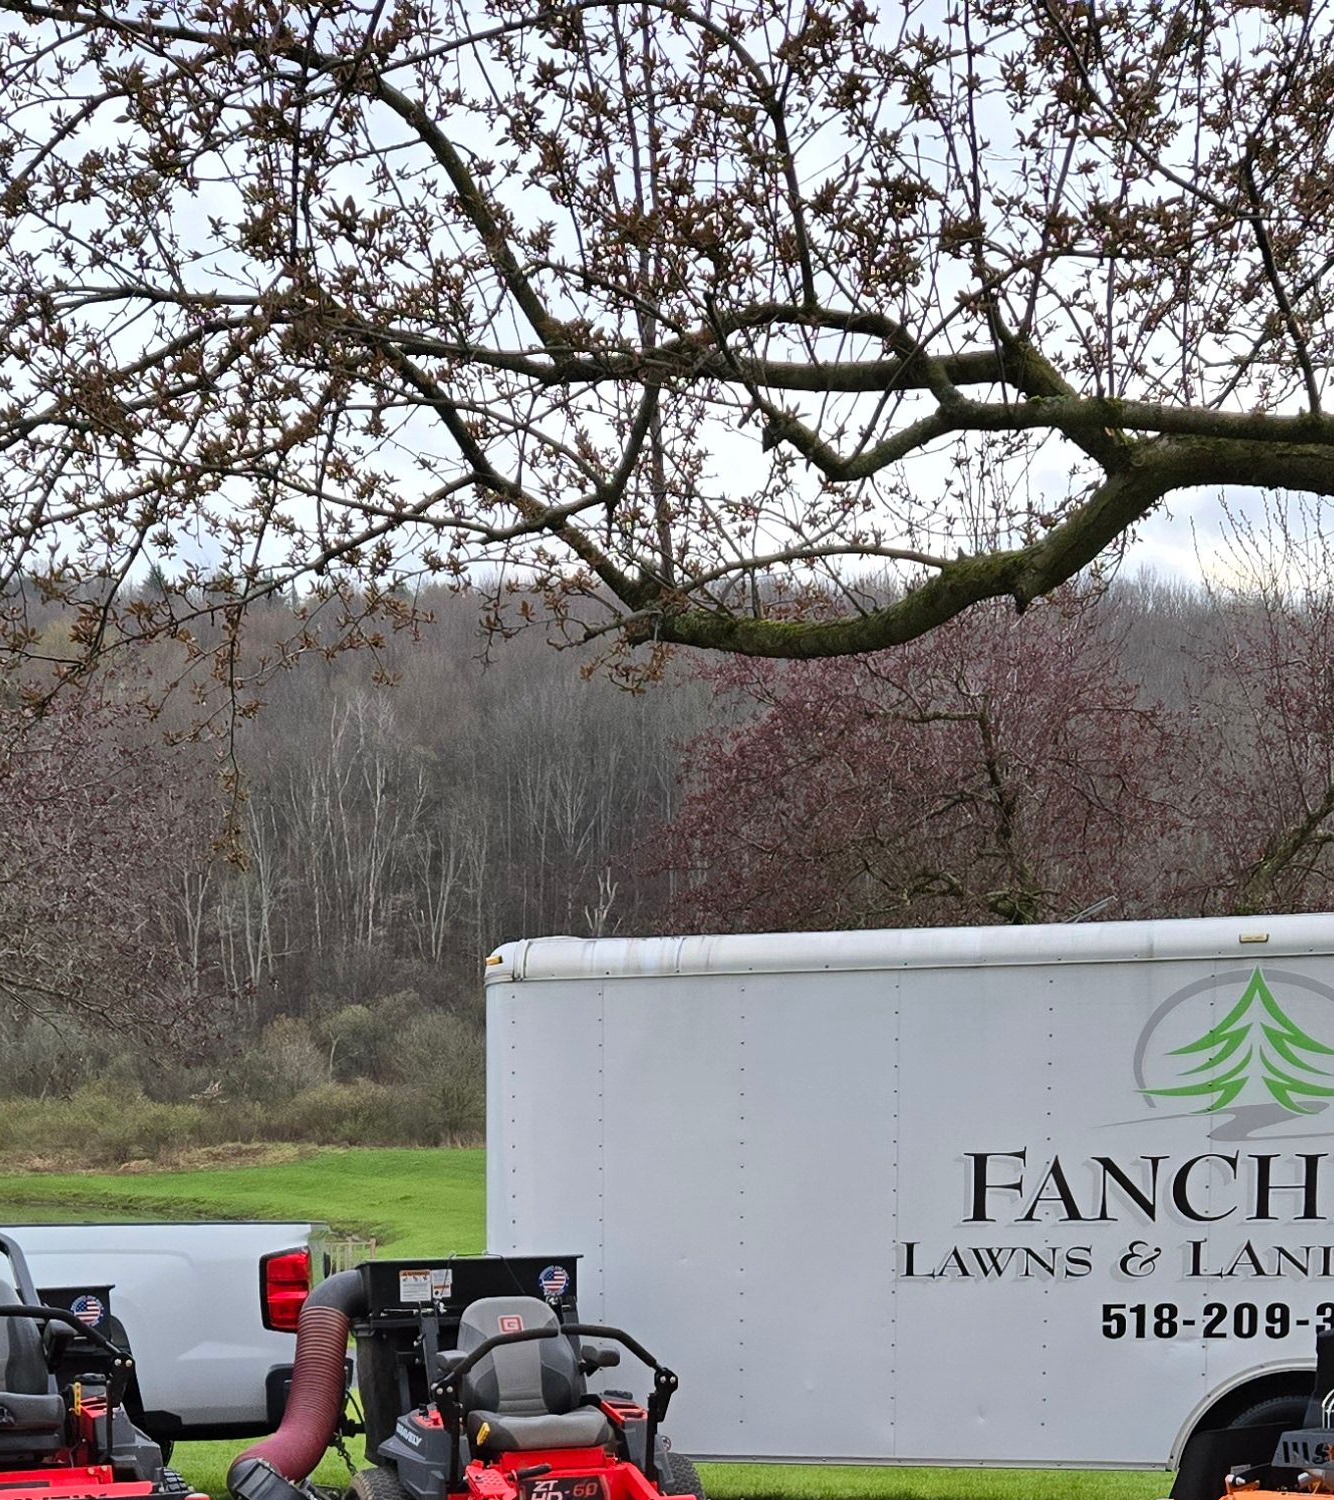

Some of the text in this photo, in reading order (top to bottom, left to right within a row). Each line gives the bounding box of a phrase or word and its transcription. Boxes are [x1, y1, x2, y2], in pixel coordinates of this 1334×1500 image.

[900, 1241, 1093, 1278] LAWNS
[1120, 1240, 1162, 1277] &
[533, 1480, 559, 1493] ZT
